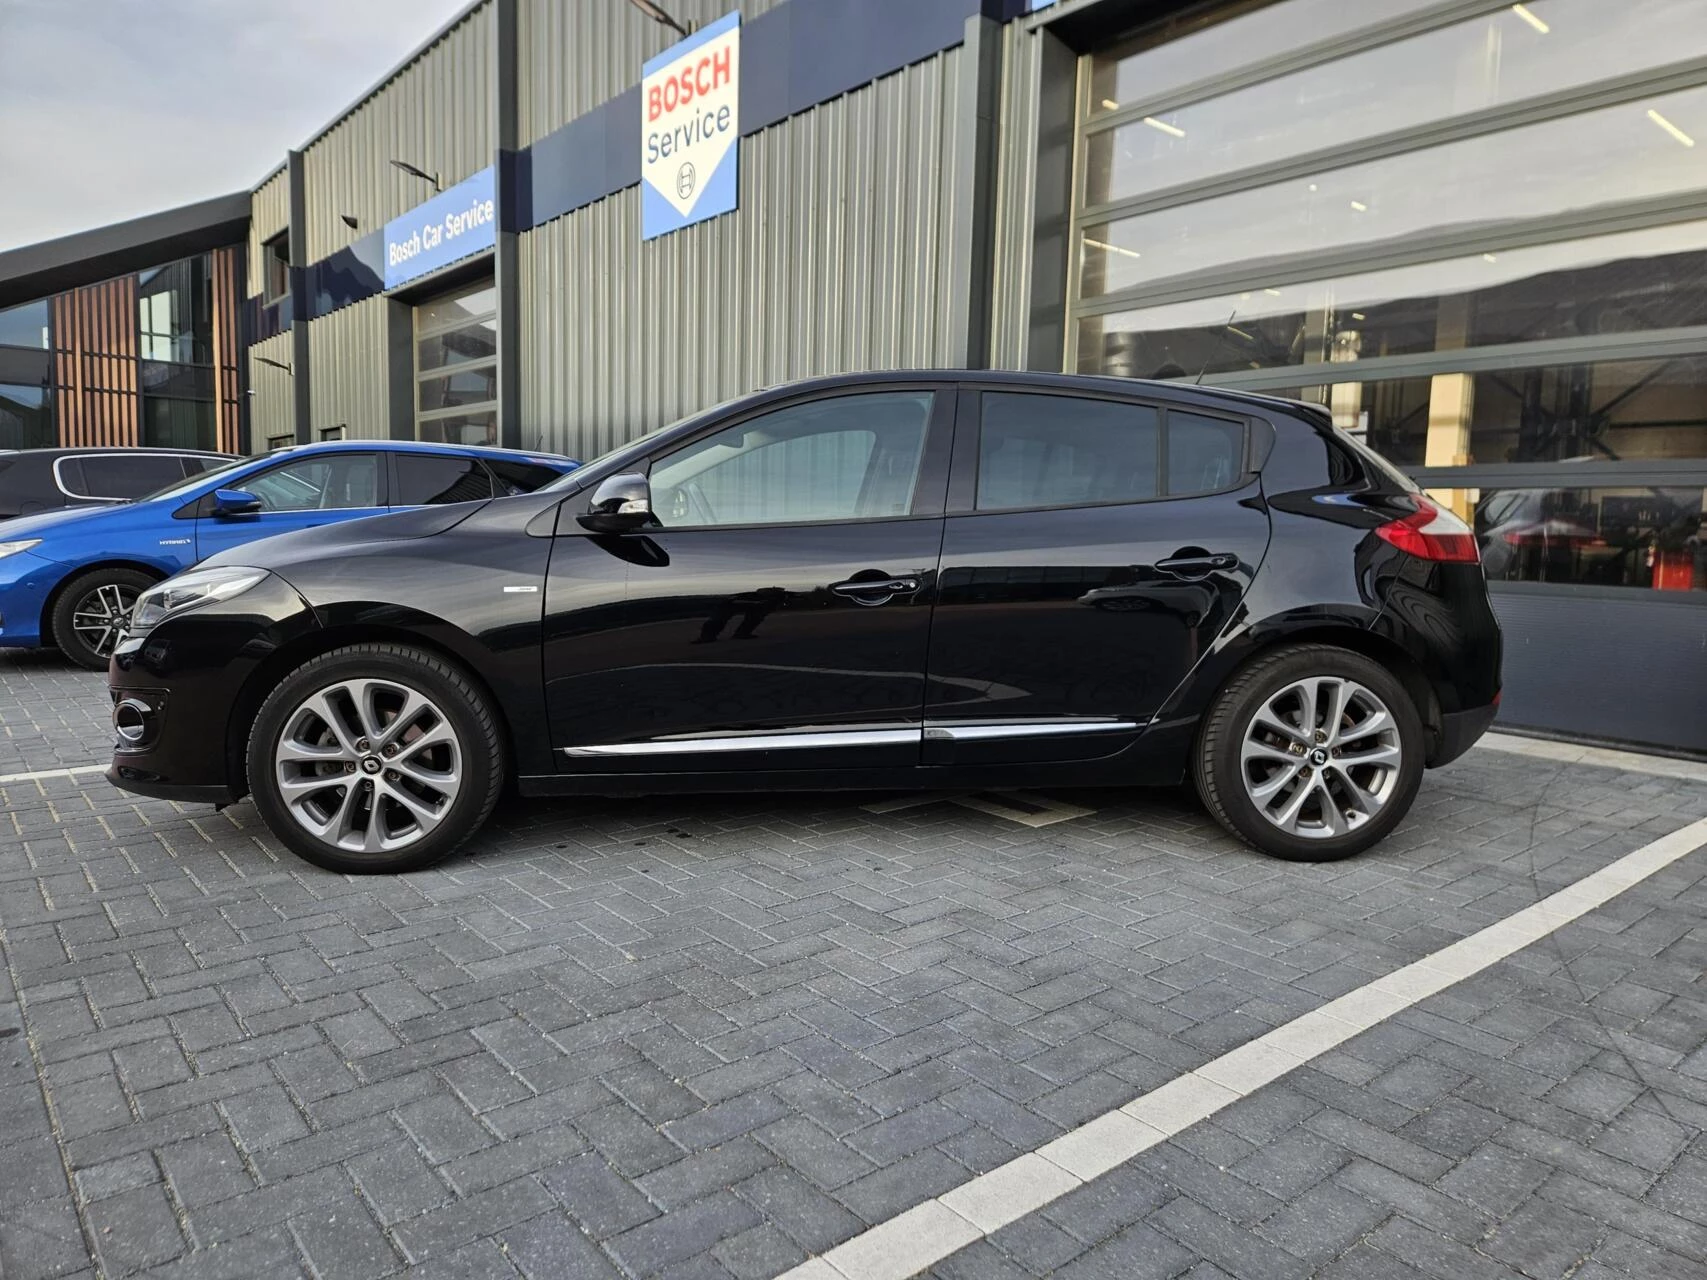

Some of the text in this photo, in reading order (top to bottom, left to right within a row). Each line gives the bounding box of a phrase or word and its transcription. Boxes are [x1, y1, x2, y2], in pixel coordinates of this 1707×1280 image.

[648, 45, 731, 123] BOSCH
[647, 103, 731, 165] Service
[389, 198, 494, 267] Bosch Car Service
